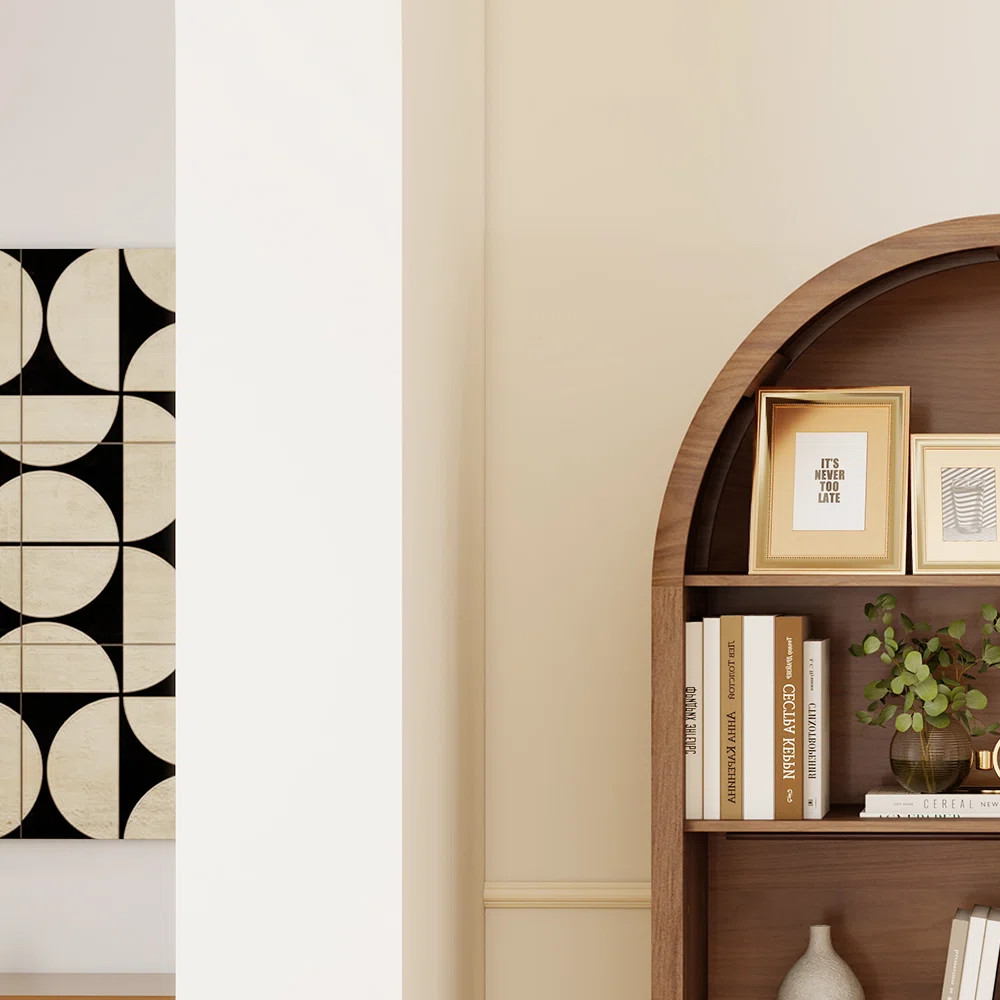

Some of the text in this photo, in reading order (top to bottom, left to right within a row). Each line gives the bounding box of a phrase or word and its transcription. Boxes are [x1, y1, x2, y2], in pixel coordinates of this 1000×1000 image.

[821, 458, 840, 469] IT'S
[814, 469, 845, 480] NEVER
[819, 481, 839, 492] TOO
[818, 492, 841, 503] LATE
[923, 799, 974, 809] CEREAL
